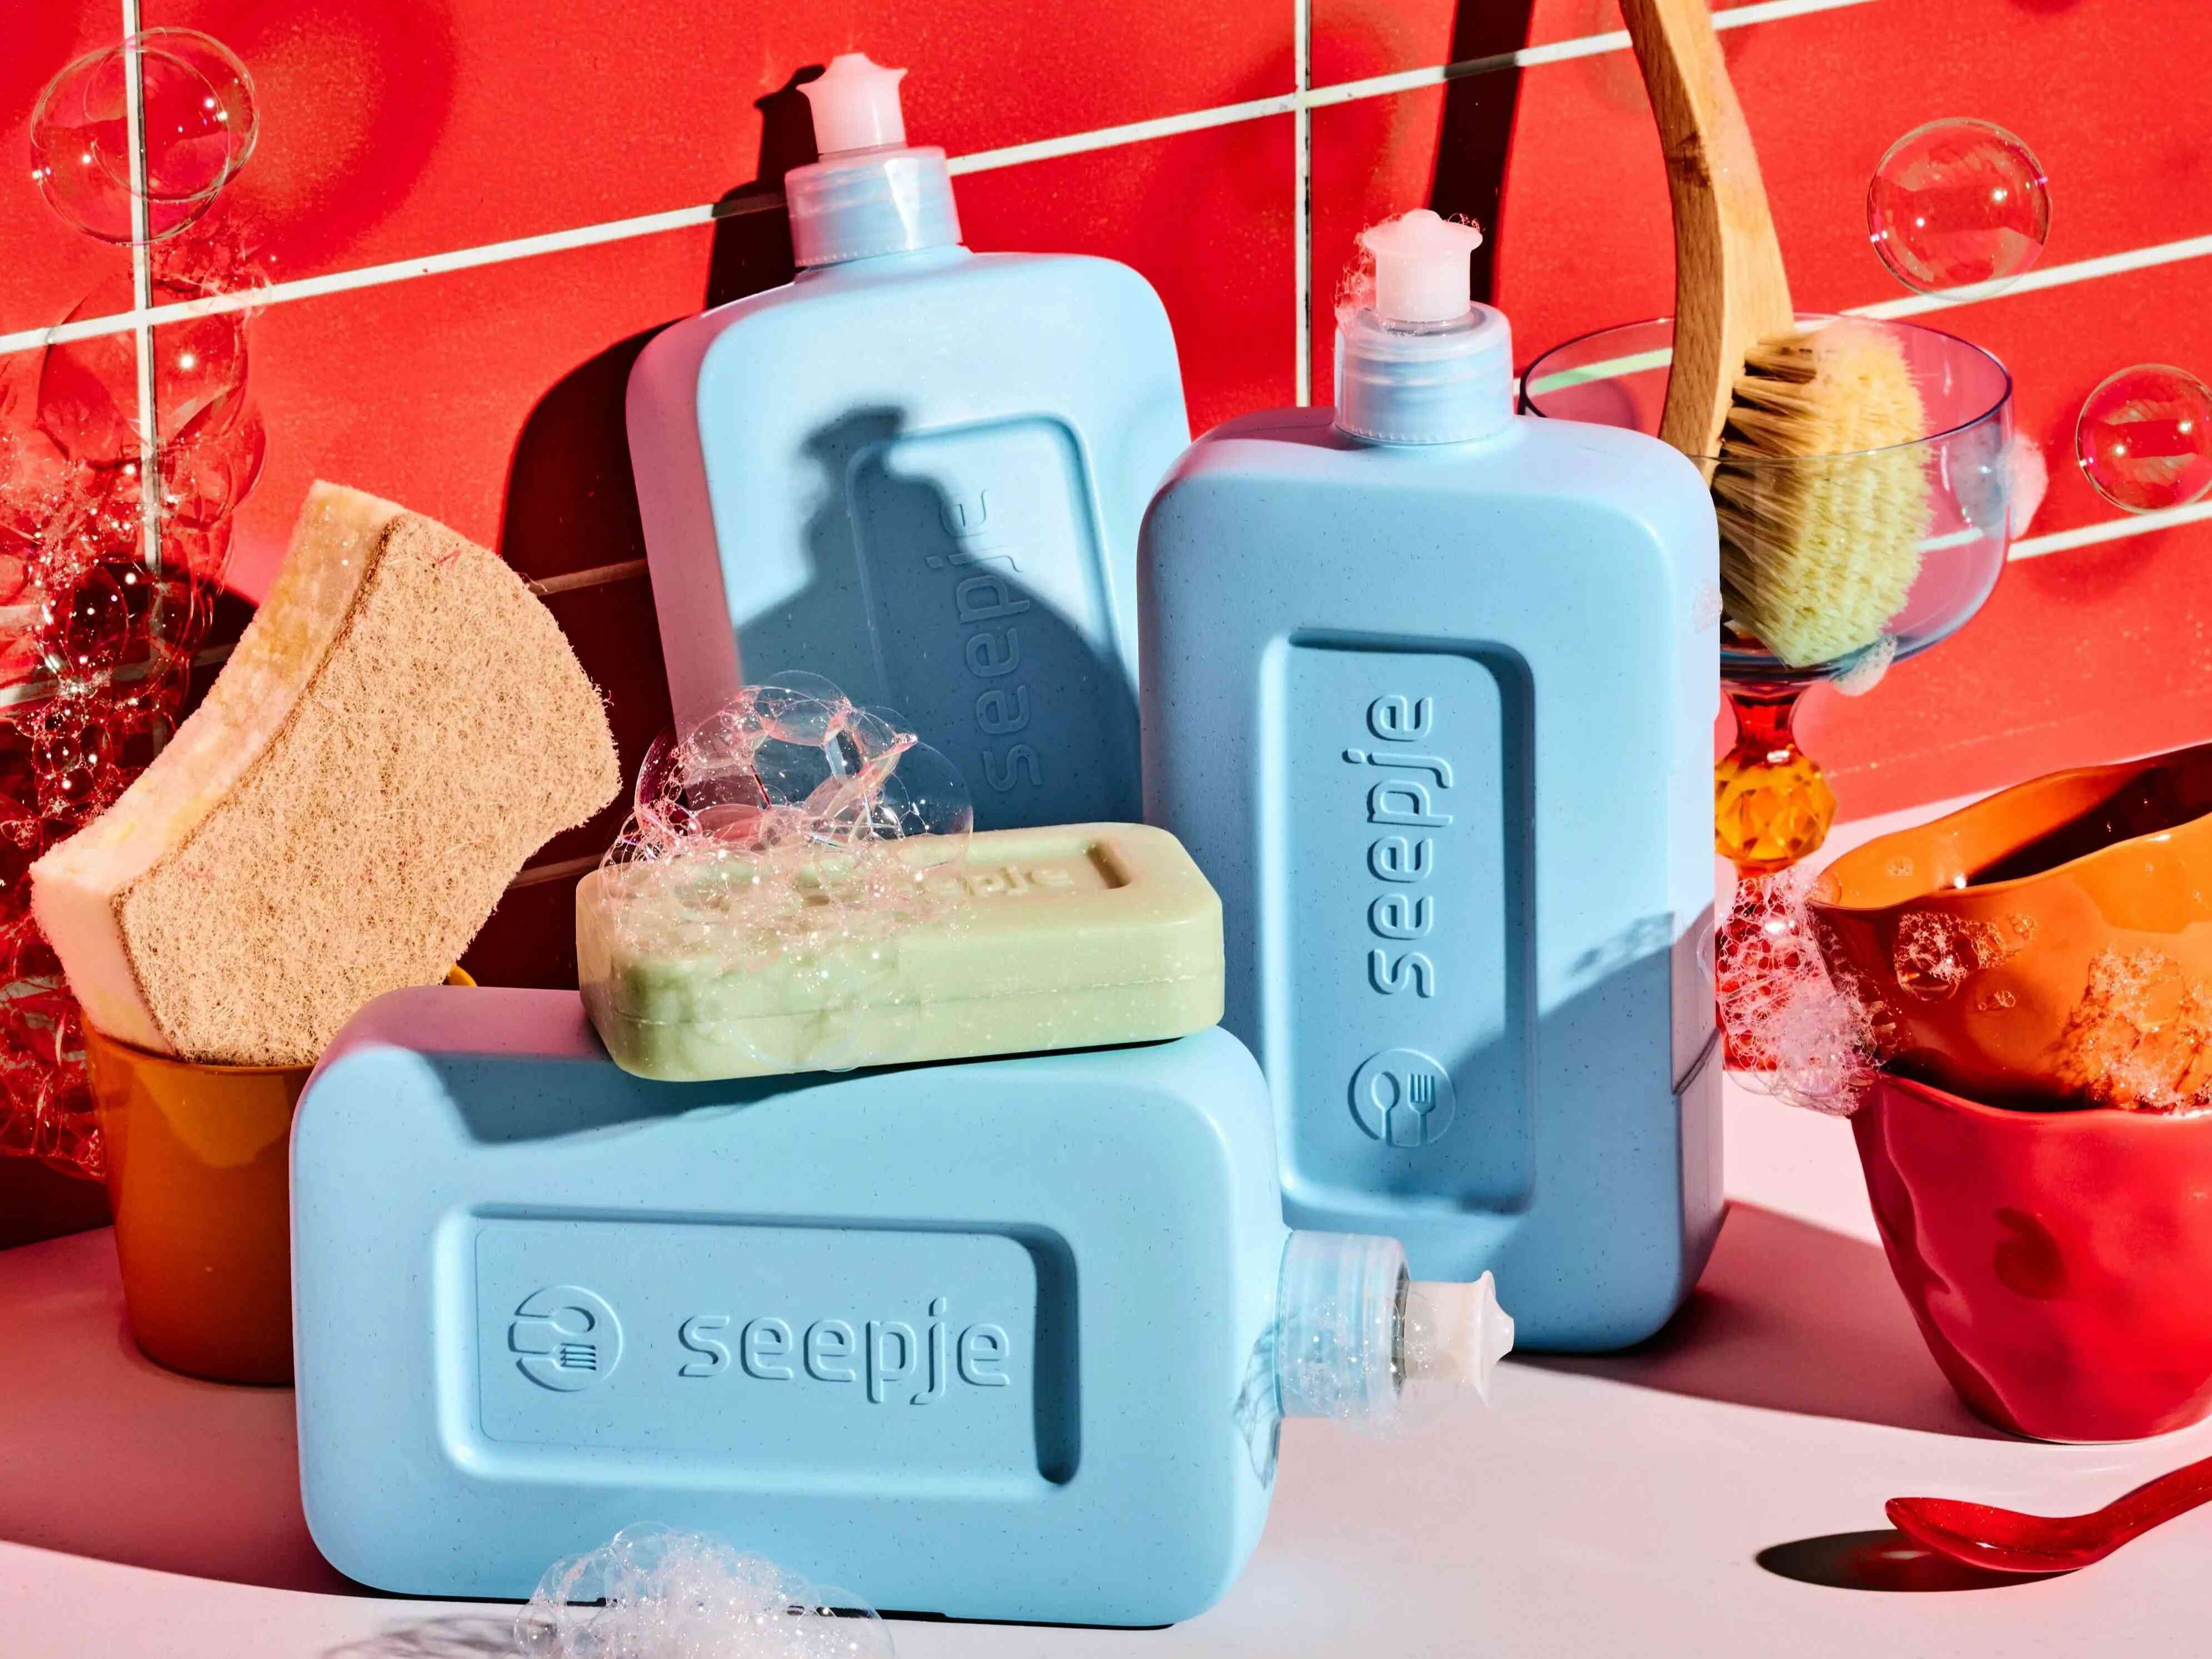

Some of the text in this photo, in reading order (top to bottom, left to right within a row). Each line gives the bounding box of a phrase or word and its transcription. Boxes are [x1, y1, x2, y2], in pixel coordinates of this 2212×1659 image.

[925, 489, 1043, 793] seepje
[1342, 694, 1453, 998] seepje
[678, 1296, 1010, 1405] seepje
